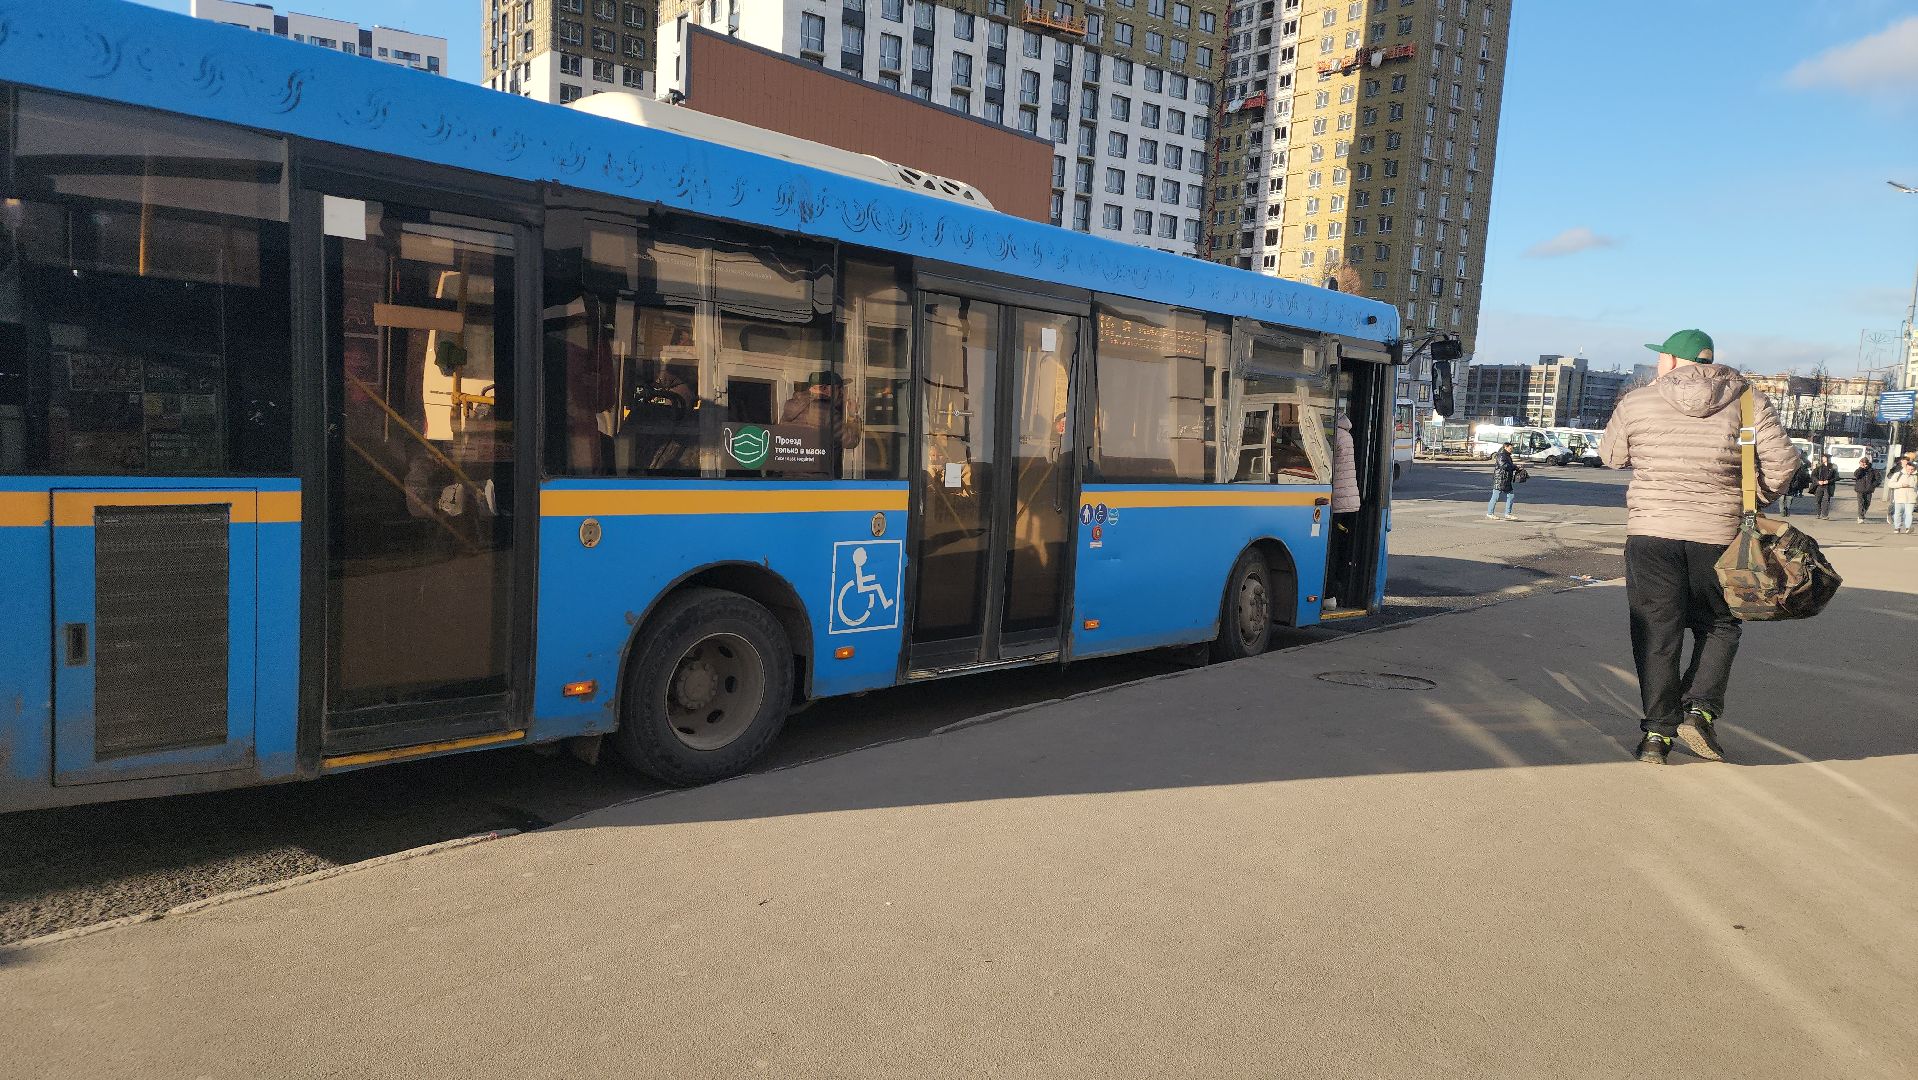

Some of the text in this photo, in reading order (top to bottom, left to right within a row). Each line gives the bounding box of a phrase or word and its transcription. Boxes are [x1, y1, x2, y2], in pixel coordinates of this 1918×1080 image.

[775, 435, 802, 447] Проезд
[774, 447, 799, 455] только
[805, 448, 827, 456] маске
